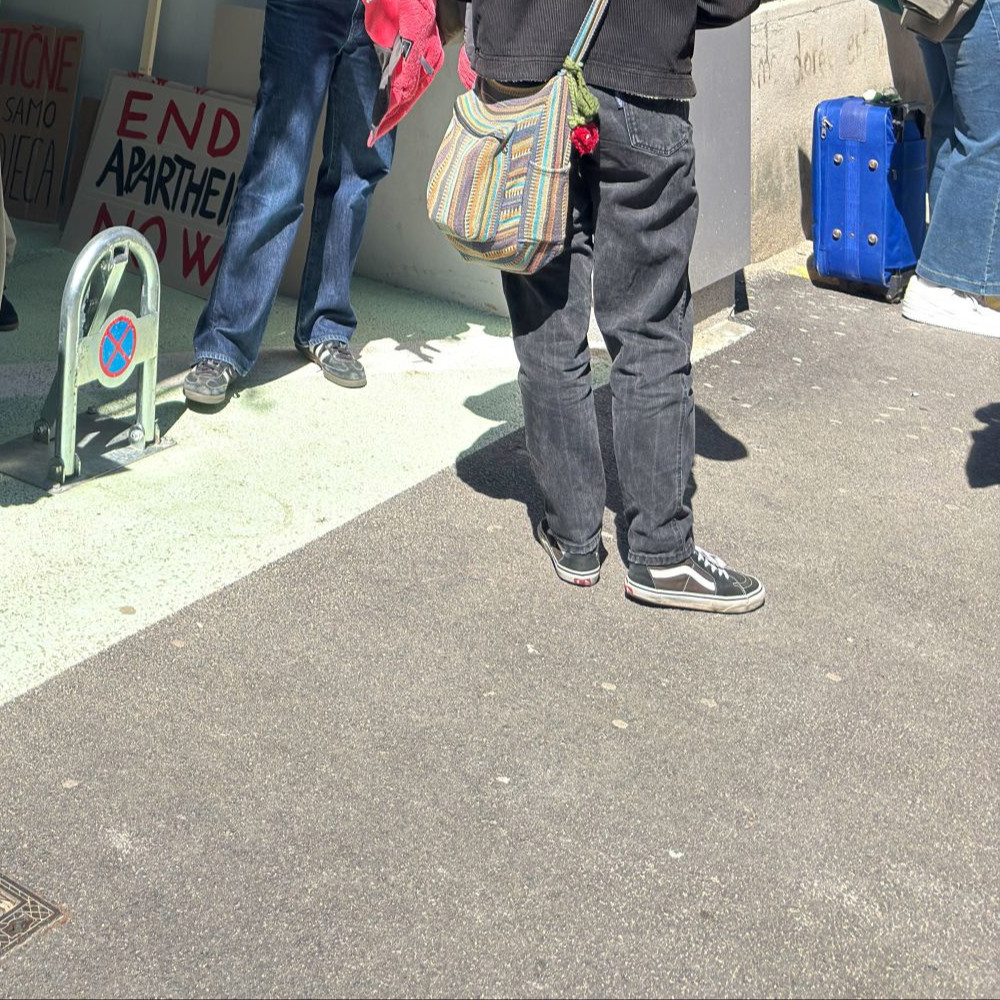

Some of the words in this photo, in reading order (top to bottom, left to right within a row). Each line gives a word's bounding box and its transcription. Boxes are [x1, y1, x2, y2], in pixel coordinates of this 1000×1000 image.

[2, 97, 56, 128] SAMO
[117, 90, 241, 158] END
[96, 139, 241, 227] APARTHEI
